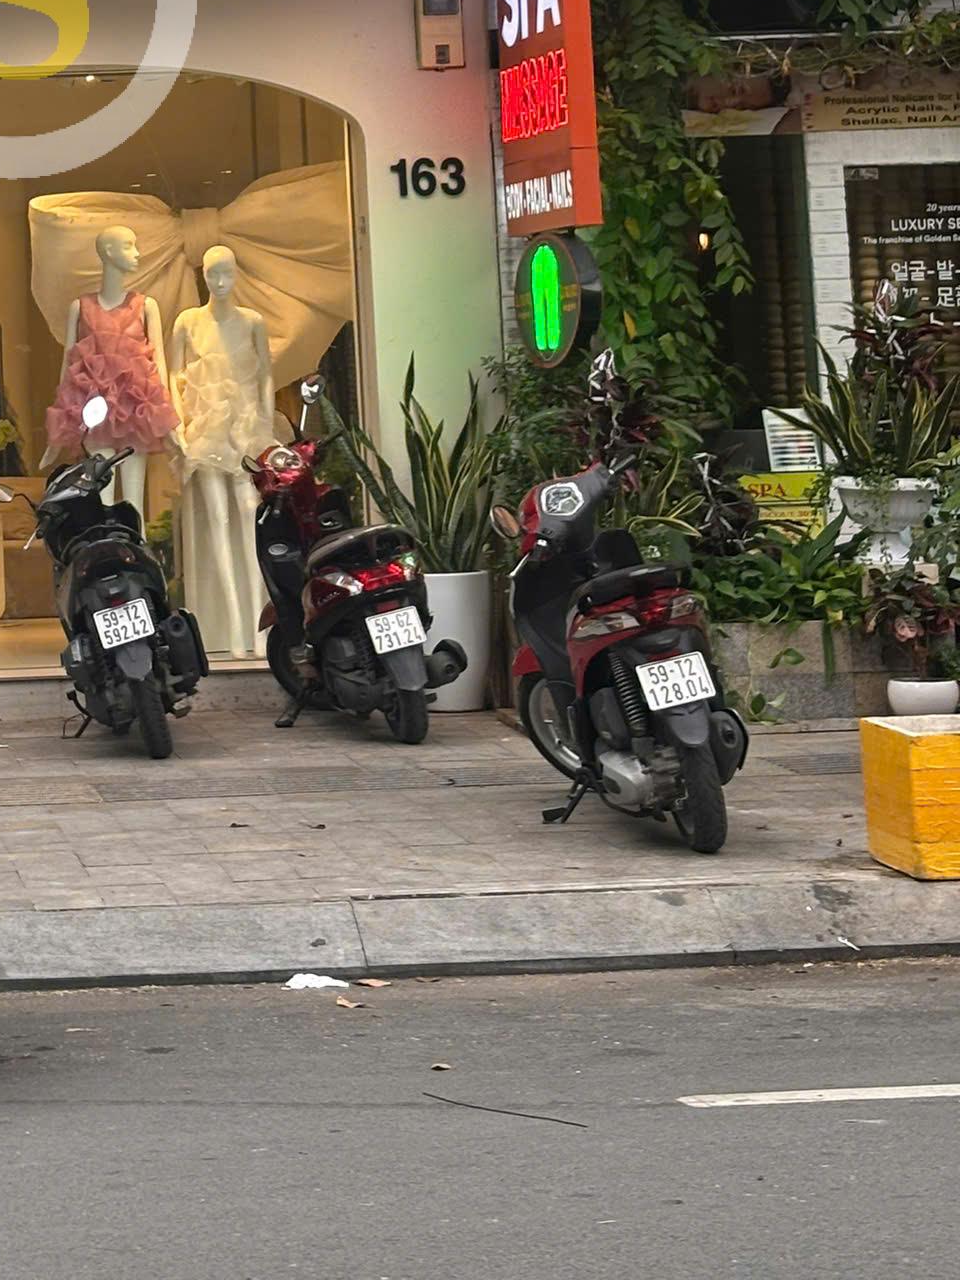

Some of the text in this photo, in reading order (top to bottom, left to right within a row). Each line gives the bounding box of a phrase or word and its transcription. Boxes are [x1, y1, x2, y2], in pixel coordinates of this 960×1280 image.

[500, 48, 568, 142] MASSAGE
[824, 94, 888, 105] Professional
[846, 106, 899, 115] Acrylic
[390, 157, 466, 197] 163
[926, 204, 937, 212] 20
[891, 218, 944, 231] LUXURY
[924, 235, 951, 243] Golden
[747, 483, 787, 498] SPA
[103, 605, 141, 627] 59-T2
[104, 620, 149, 644] 592.42
[376, 627, 421, 650] 731.24
[647, 658, 697, 685] 59-T2
[649, 675, 709, 707] 128.04
